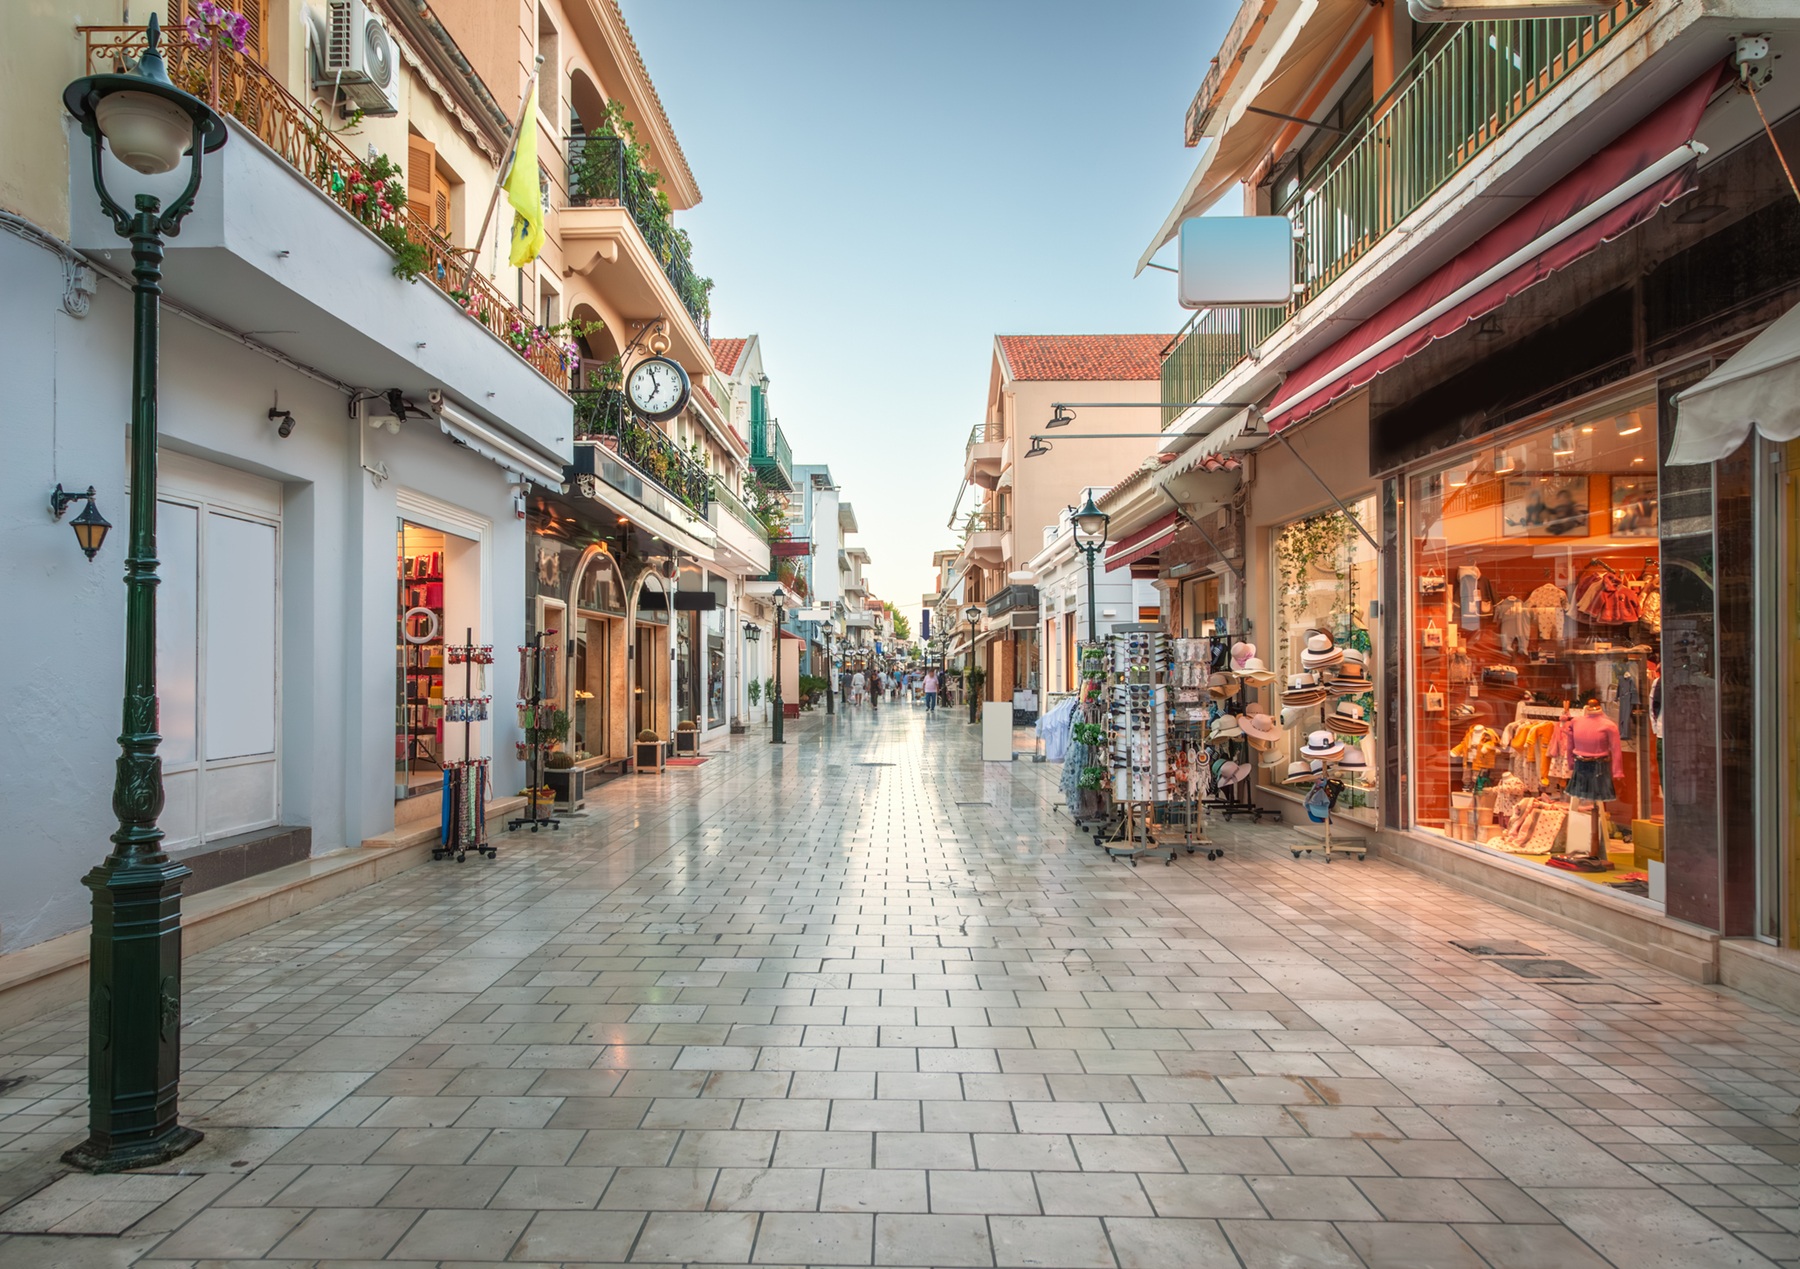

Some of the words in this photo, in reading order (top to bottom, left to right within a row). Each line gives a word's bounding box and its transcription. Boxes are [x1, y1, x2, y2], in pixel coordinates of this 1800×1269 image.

[654, 365, 661, 373] 12
[671, 375, 677, 383] 2
[673, 385, 679, 393] 3
[663, 401, 669, 409] 5
